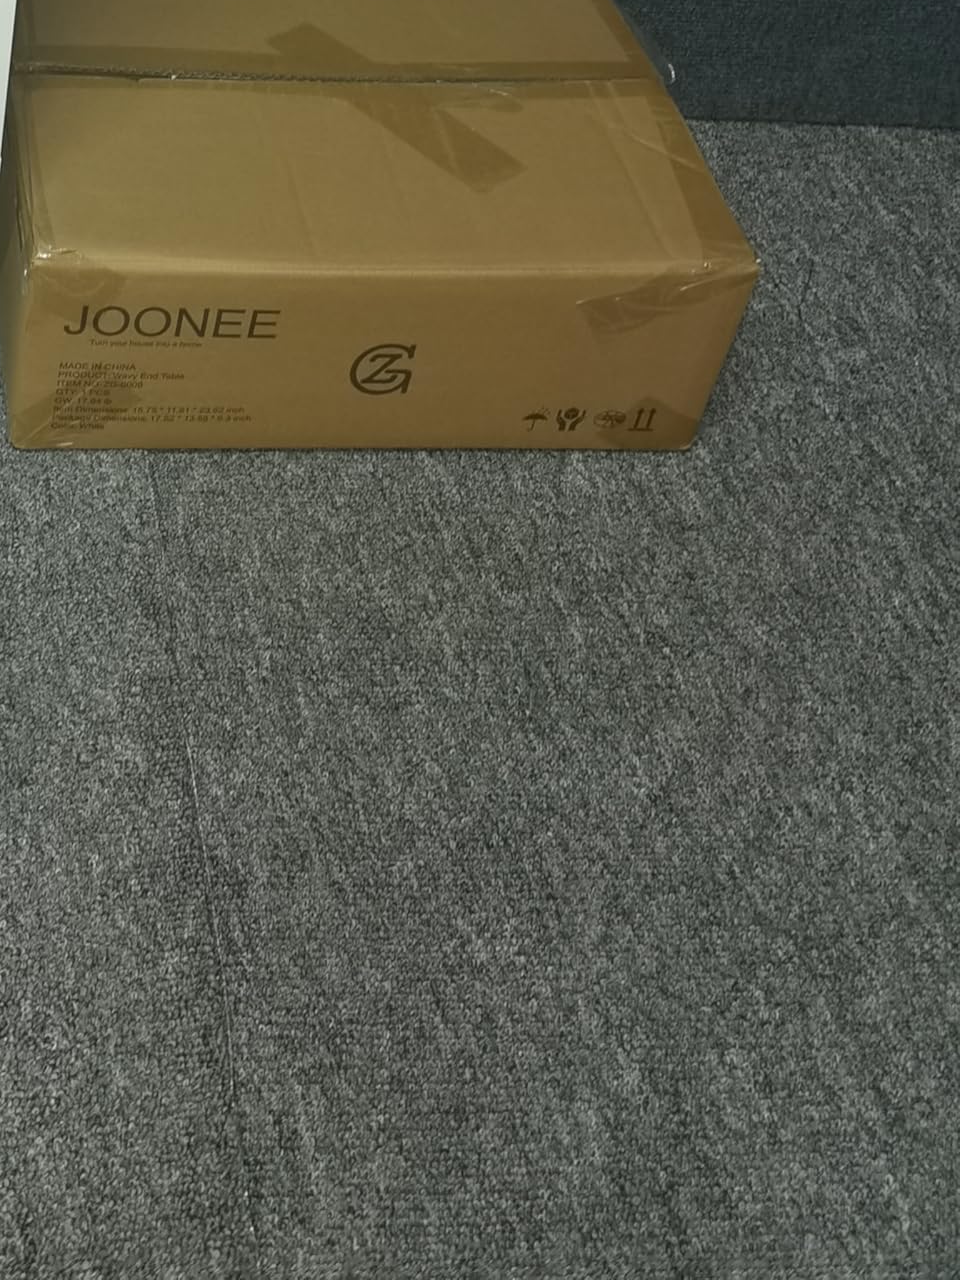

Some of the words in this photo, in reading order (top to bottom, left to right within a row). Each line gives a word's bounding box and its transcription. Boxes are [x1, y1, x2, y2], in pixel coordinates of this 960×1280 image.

[64, 305, 281, 339] JOONEE
[59, 361, 89, 371] MADE
[90, 362, 103, 371] IN
[103, 362, 137, 372] CHINA
